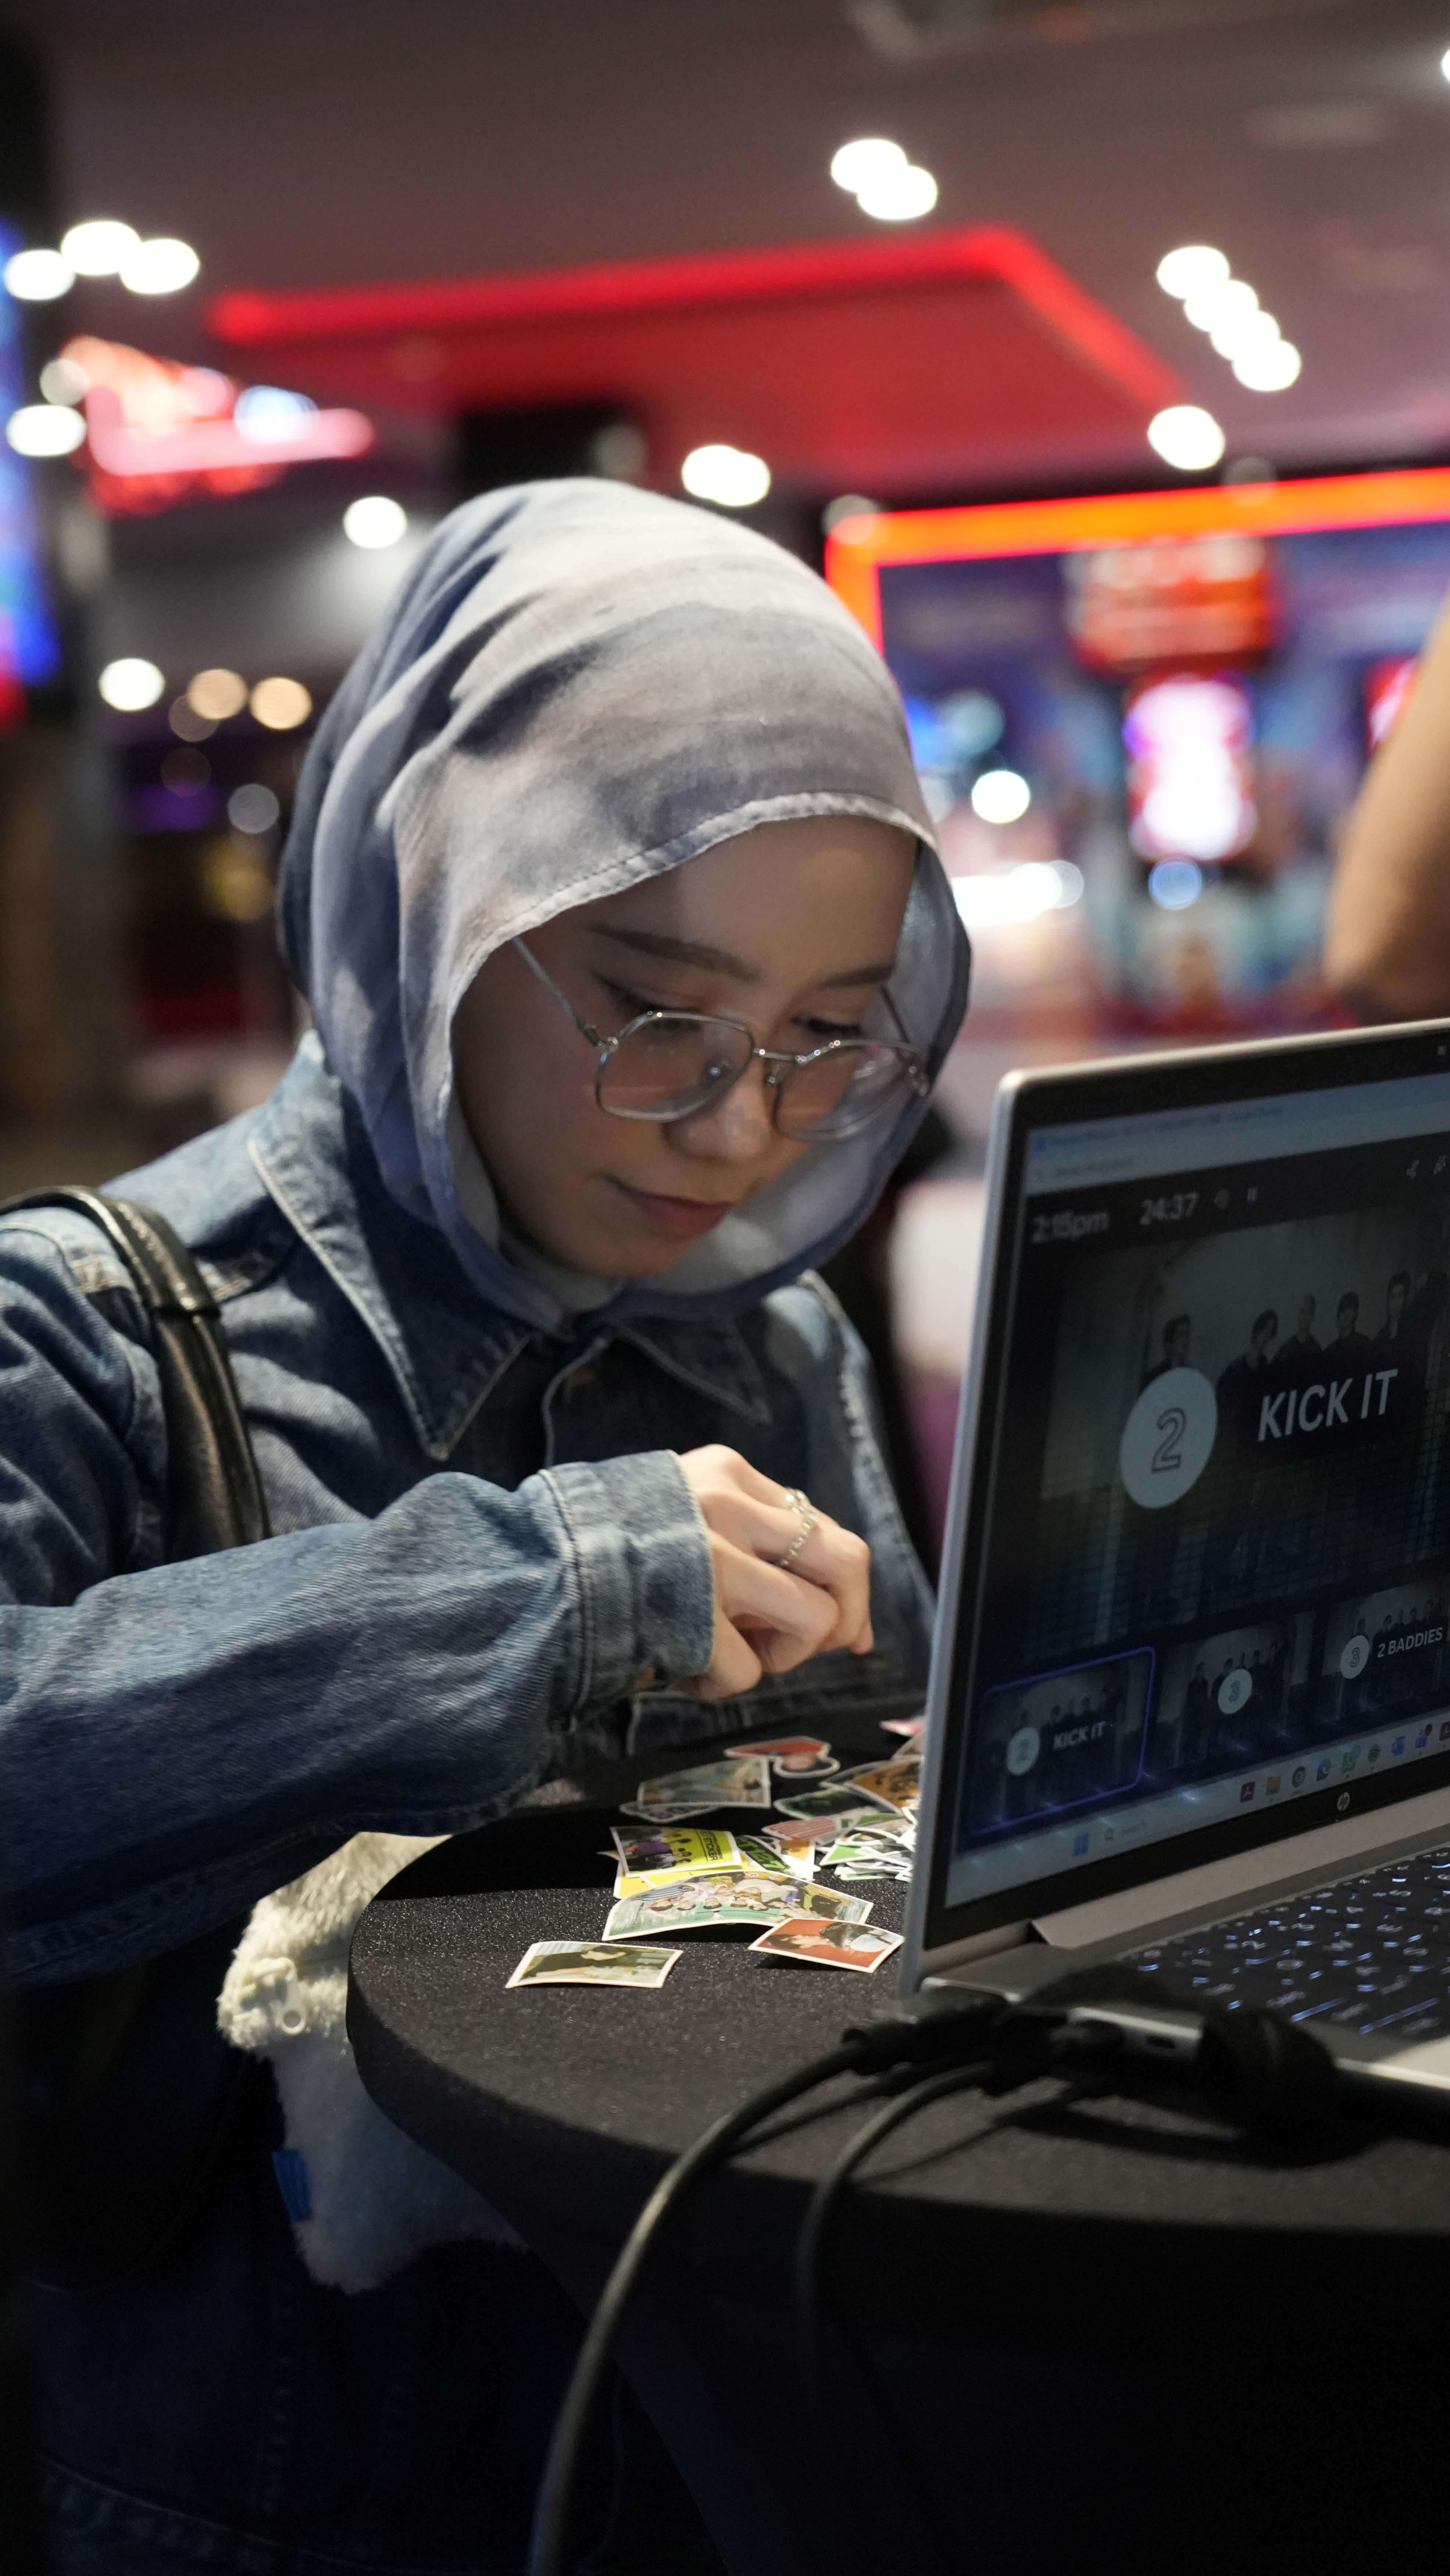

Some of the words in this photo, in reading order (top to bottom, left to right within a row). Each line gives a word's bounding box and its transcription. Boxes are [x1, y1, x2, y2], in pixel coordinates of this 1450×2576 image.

[1139, 1192, 1199, 1225] 24:37
[1257, 1378, 1353, 1442] KICK
[1361, 1370, 1398, 1419] IT
[1151, 1407, 1187, 1473] 2
[1350, 1647, 1360, 1667] 3
[1377, 1643, 1385, 1658] 2
[1388, 1627, 1443, 1654] BADDIES
[1228, 1681, 1240, 1702] 3
[1053, 1727, 1089, 1750] KICK
[1091, 1721, 1106, 1738] IT
